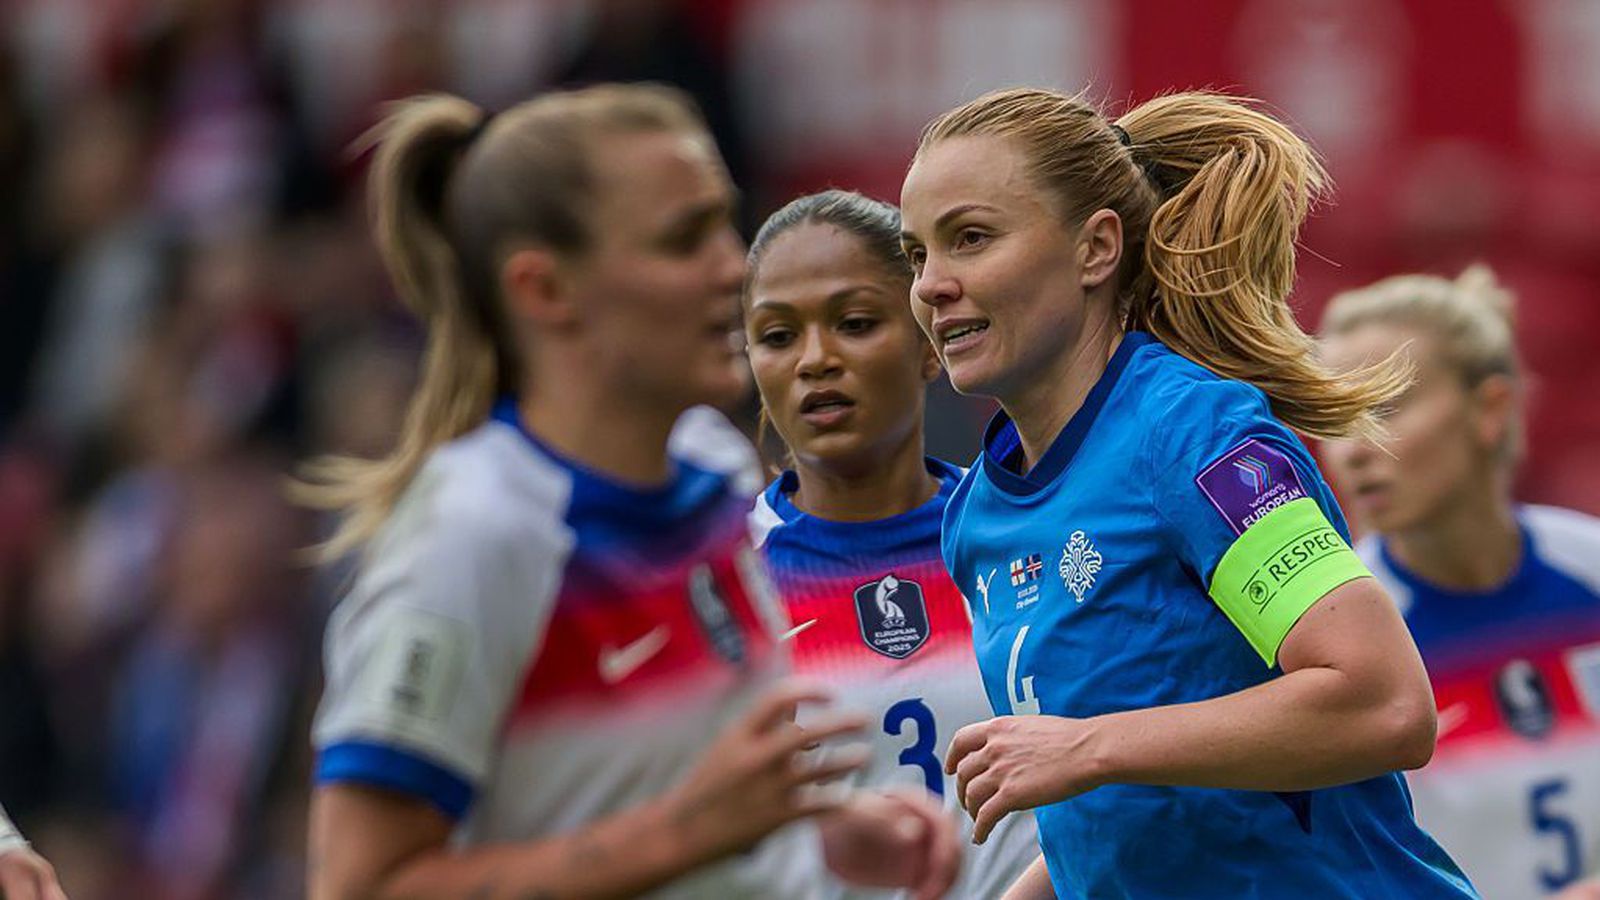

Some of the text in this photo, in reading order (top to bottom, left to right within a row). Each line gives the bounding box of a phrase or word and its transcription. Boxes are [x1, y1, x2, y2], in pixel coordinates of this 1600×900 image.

[1241, 487, 1302, 528] EUROPEAN
[1007, 625, 1041, 716] 4
[883, 698, 945, 797] 3
[1528, 778, 1582, 894] 5
